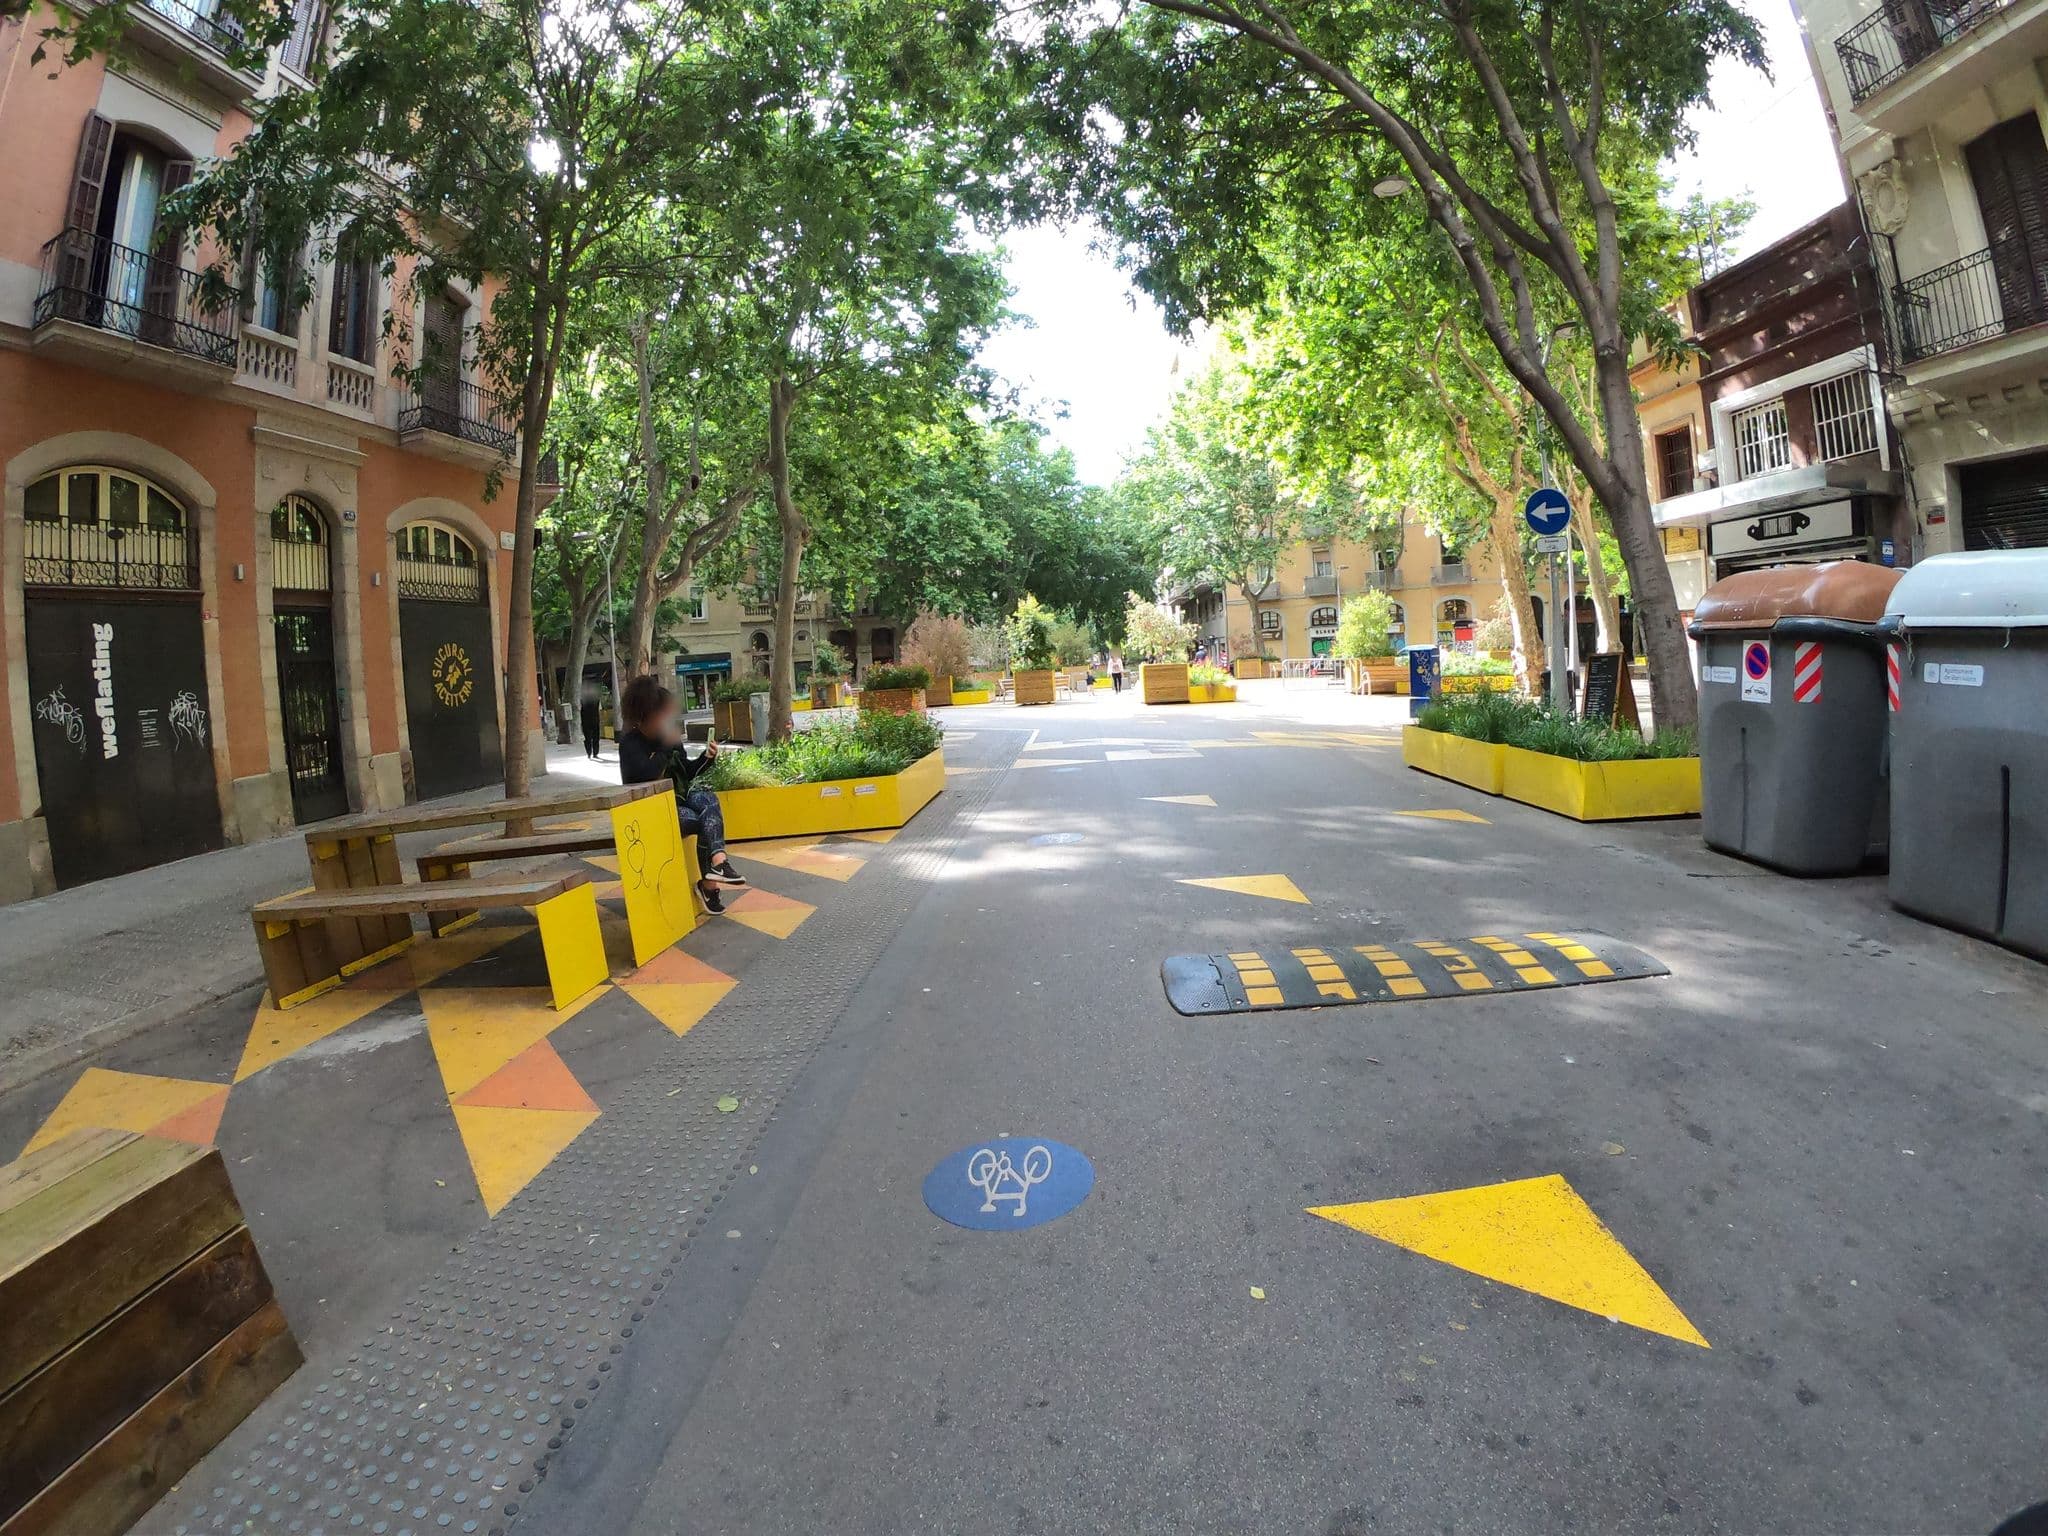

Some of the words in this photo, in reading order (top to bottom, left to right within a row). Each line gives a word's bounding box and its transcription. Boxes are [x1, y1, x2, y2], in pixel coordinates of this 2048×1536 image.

[432, 643, 473, 677] SUCURSAL
[92, 622, 119, 760] weflating
[434, 680, 473, 707] ACEITERA
